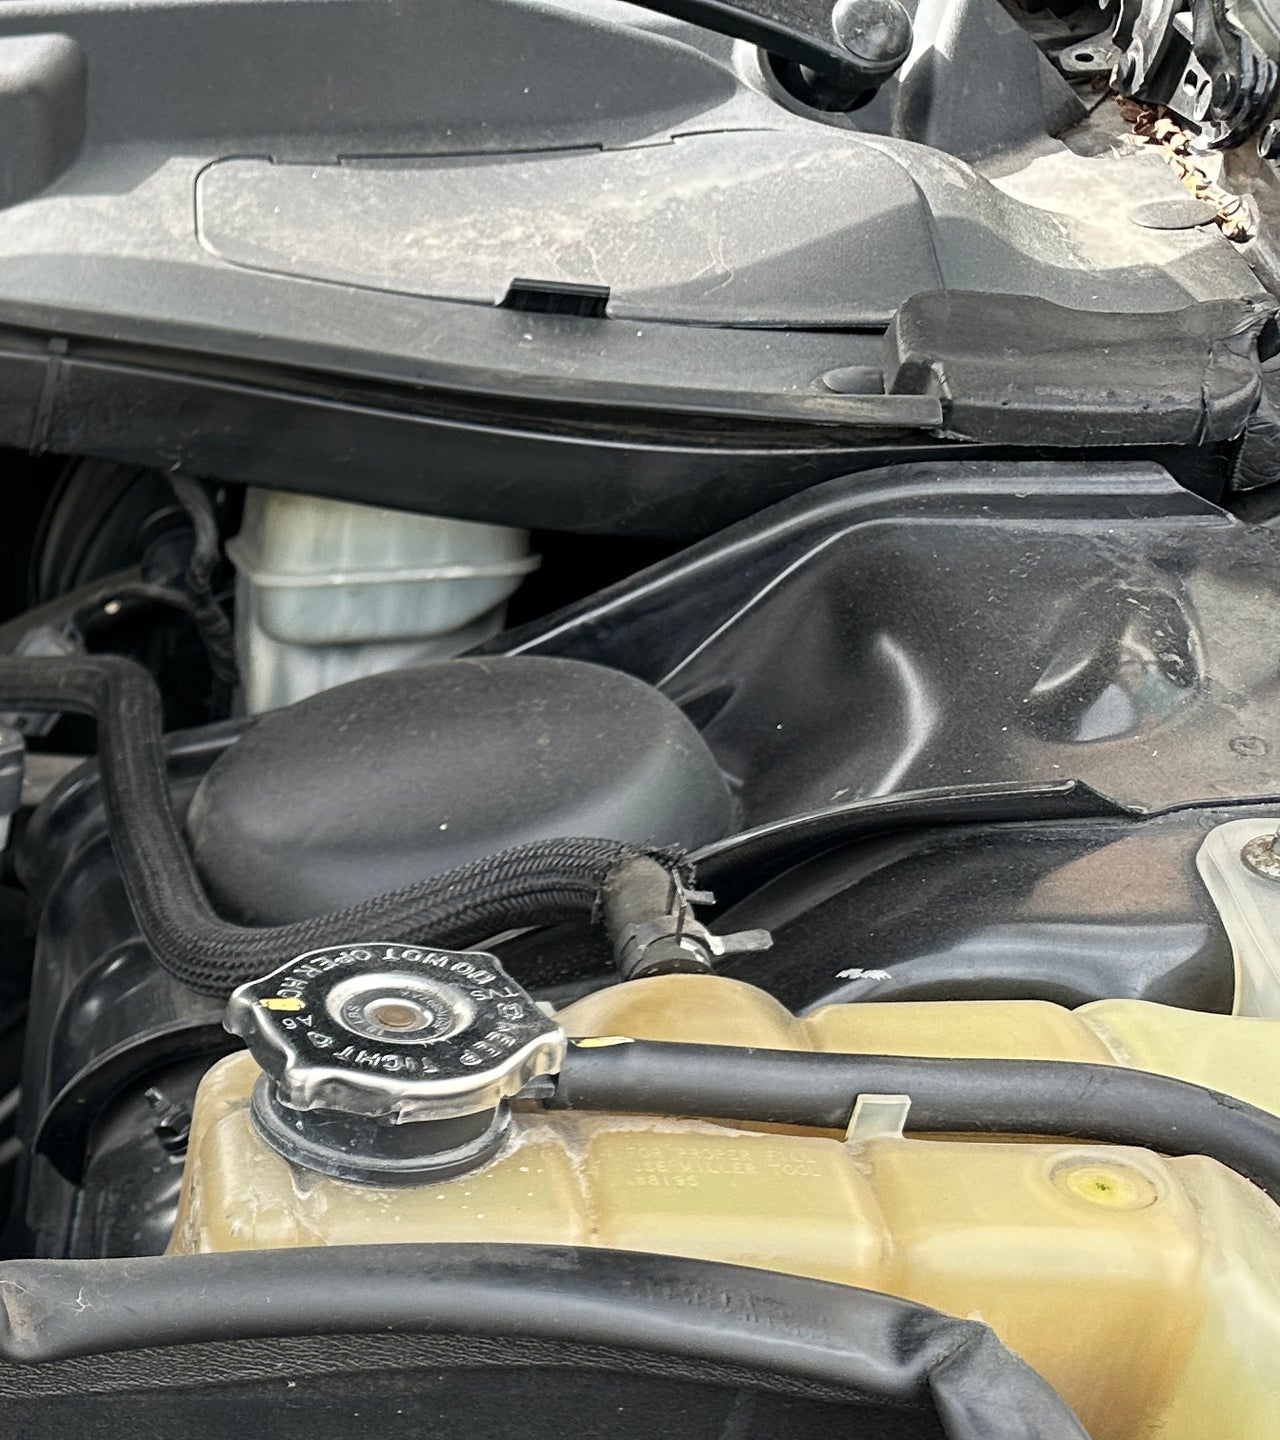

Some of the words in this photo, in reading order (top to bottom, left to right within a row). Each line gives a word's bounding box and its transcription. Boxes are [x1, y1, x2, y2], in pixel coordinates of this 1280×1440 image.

[382, 948, 450, 969] NOT
[451, 960, 497, 985] DO
[282, 1013, 315, 1031] A6
